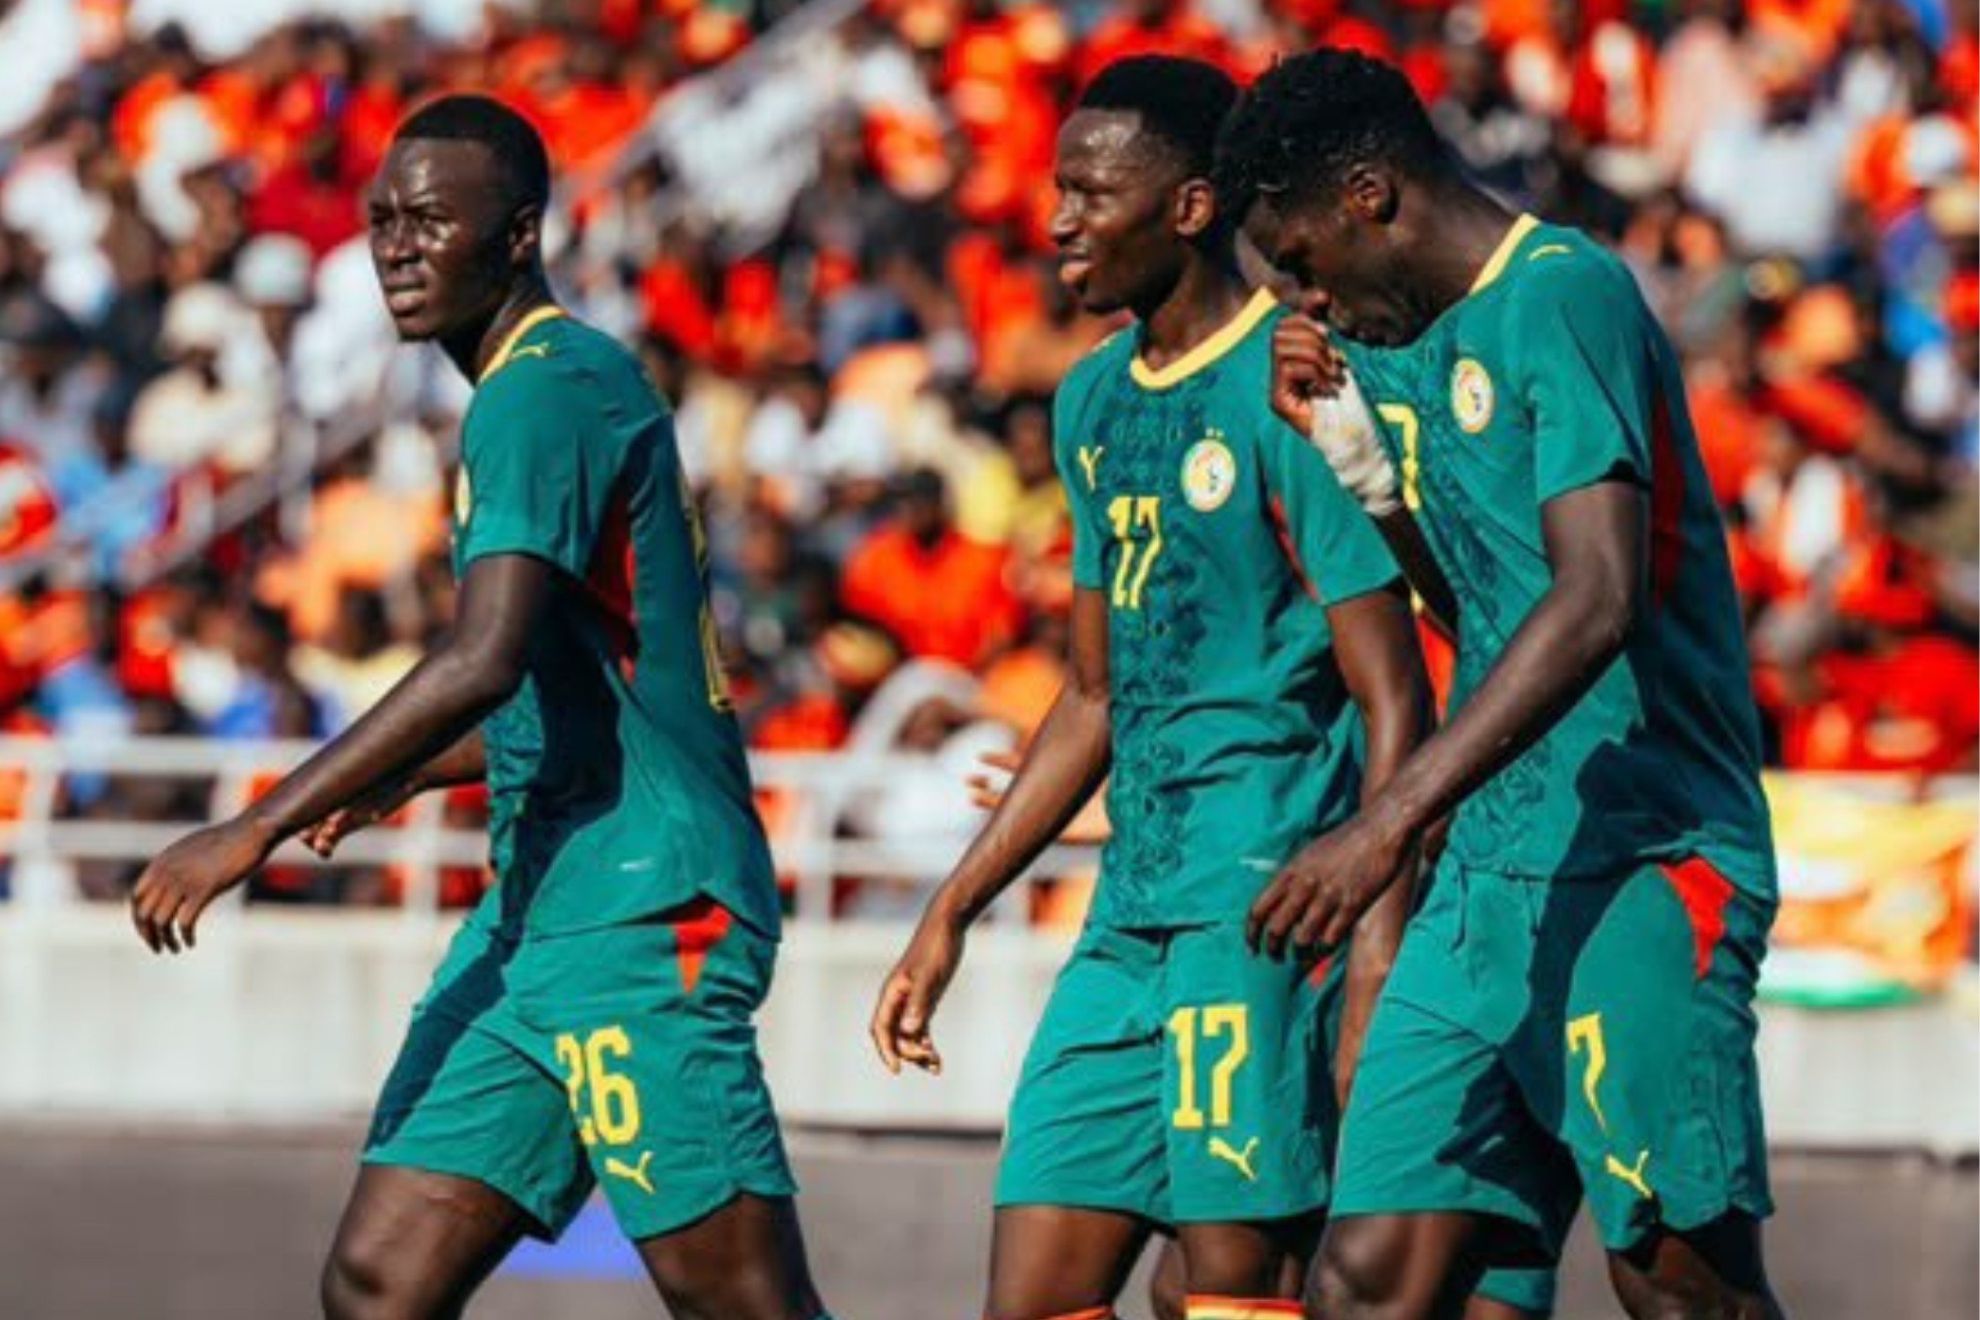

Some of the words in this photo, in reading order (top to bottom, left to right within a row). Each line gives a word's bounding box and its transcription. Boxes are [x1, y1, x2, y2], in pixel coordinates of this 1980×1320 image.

[1108, 496, 1162, 609] 17
[554, 1026, 639, 1144] 26
[1168, 1004, 1248, 1128] 17
[1566, 1012, 1606, 1137] 7
